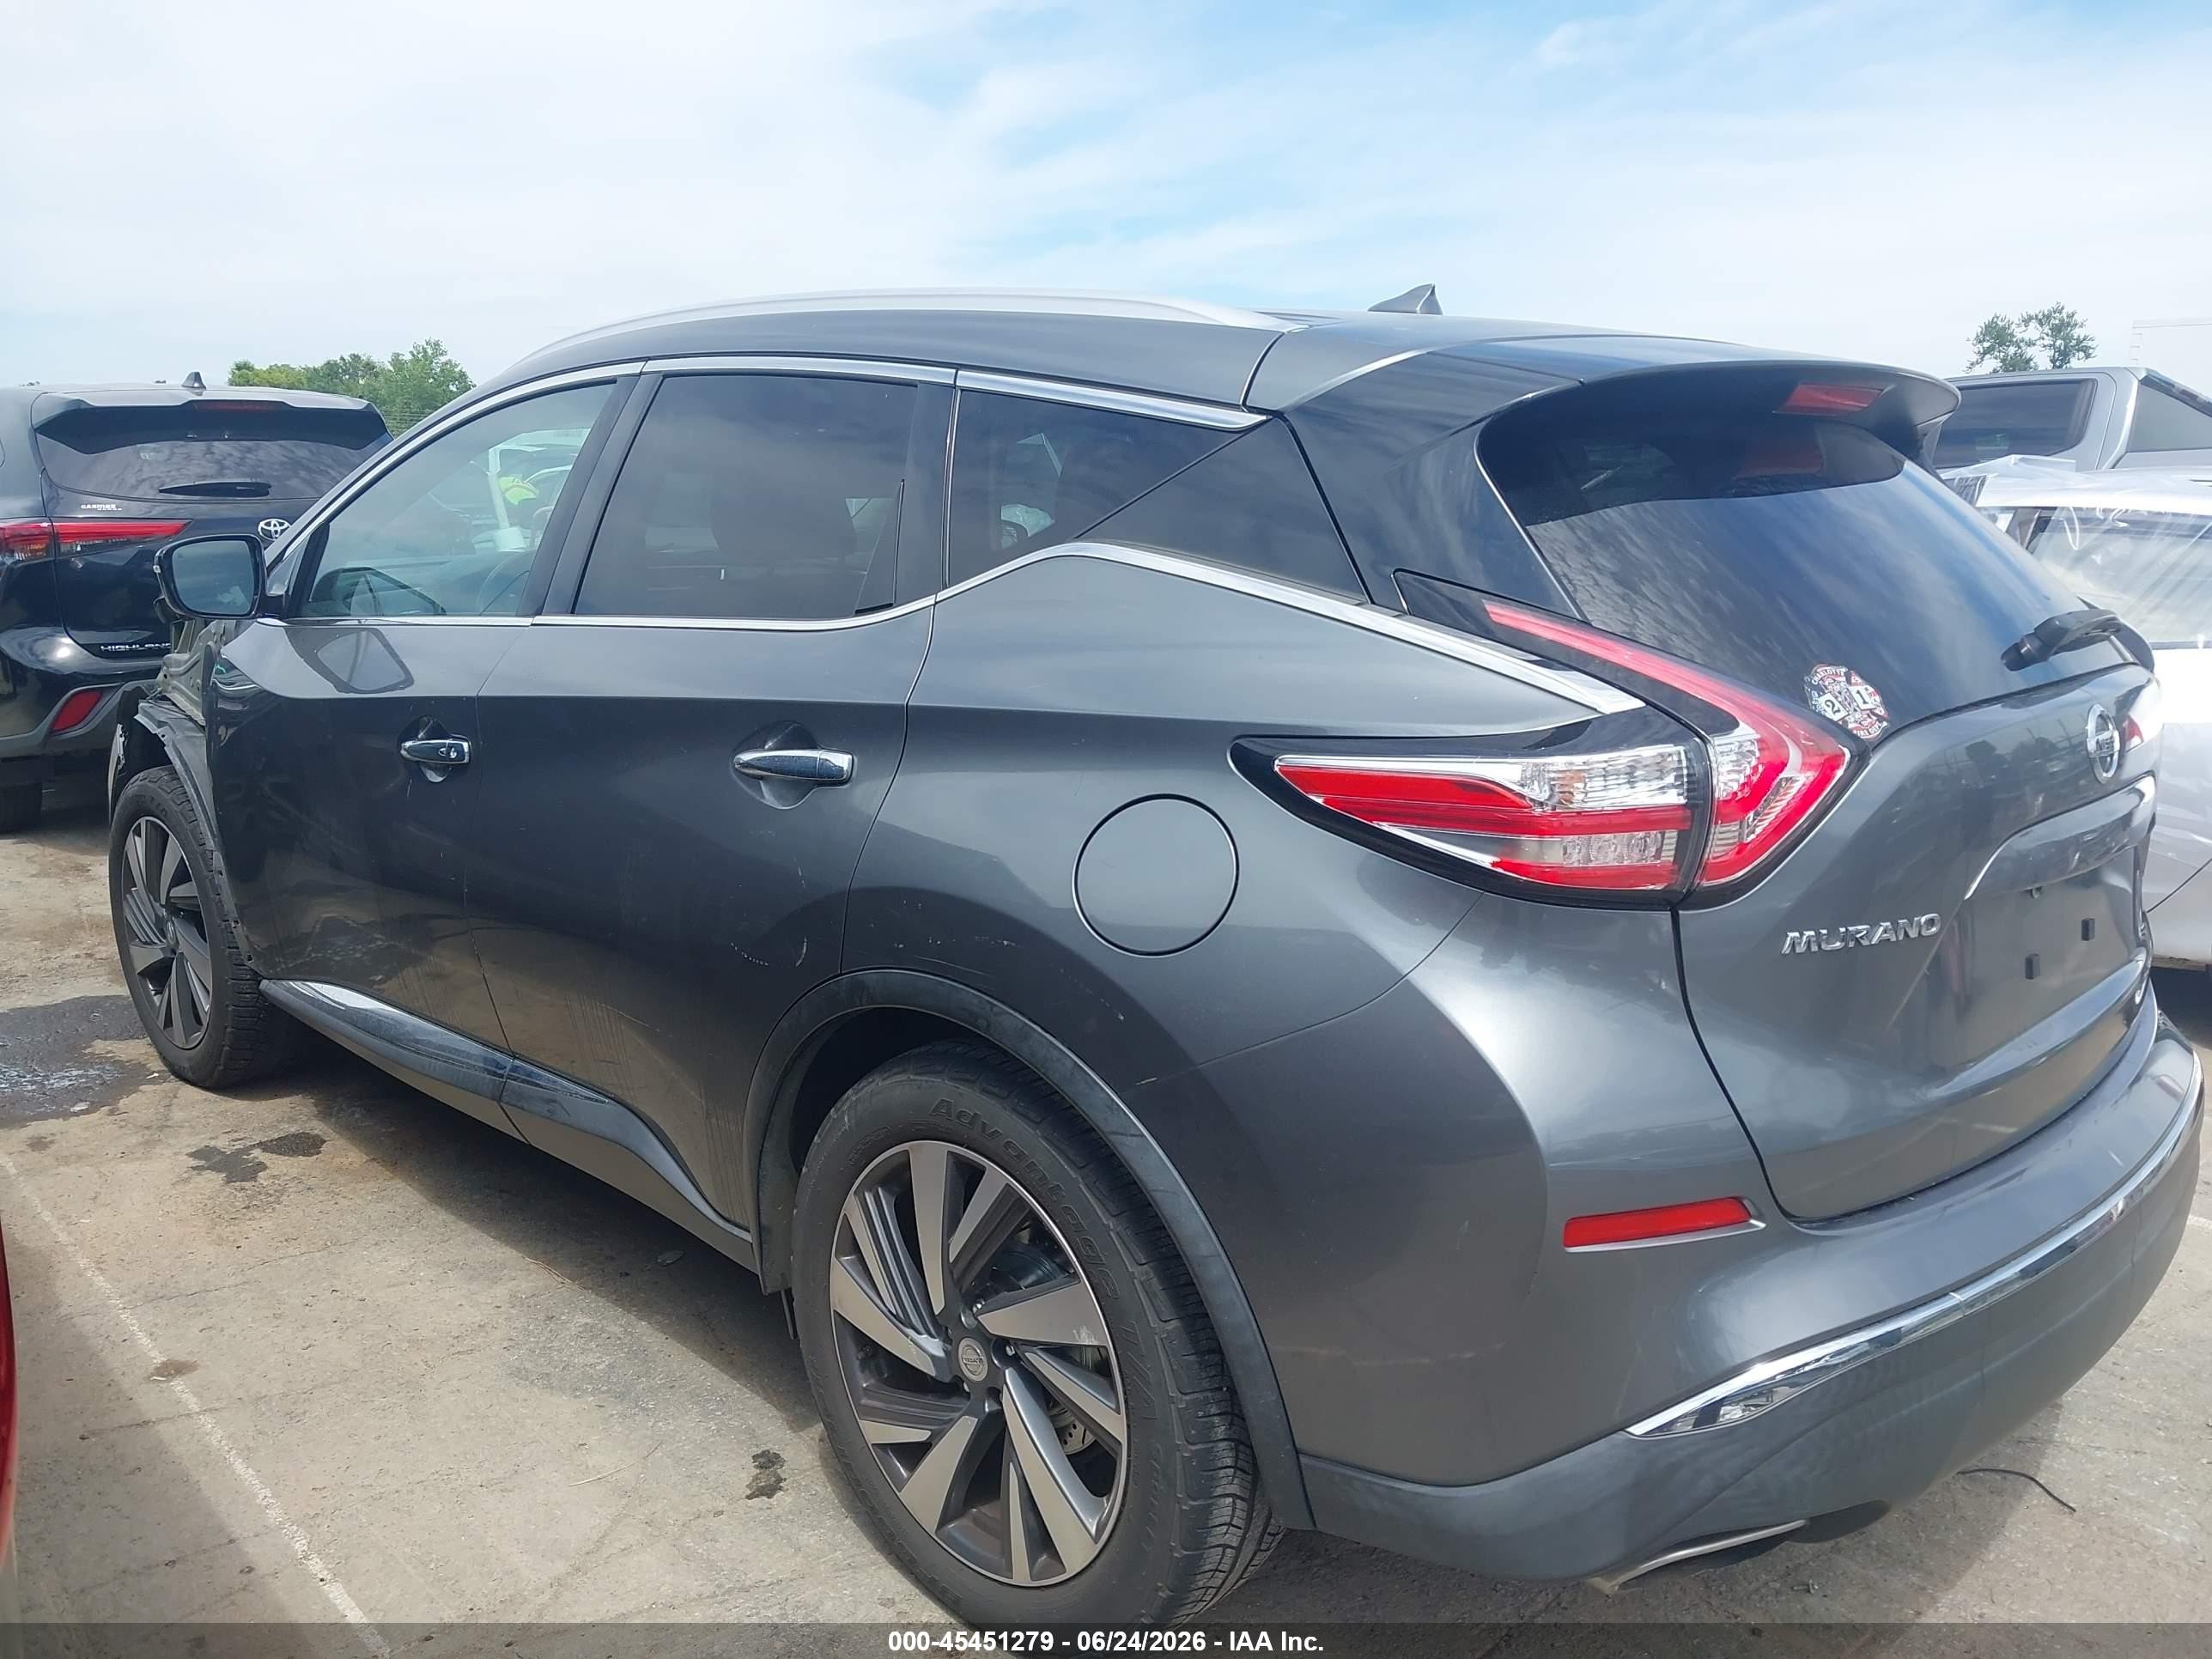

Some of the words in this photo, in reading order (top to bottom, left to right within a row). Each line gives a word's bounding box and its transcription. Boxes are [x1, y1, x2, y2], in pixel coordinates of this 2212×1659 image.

[1811, 670, 1845, 685] CHARLOTTE
[1824, 698, 1842, 715] 2
[1856, 690, 1869, 704] 1
[1781, 913, 1942, 955] MURANO
[929, 1098, 1120, 1299] Advantage
